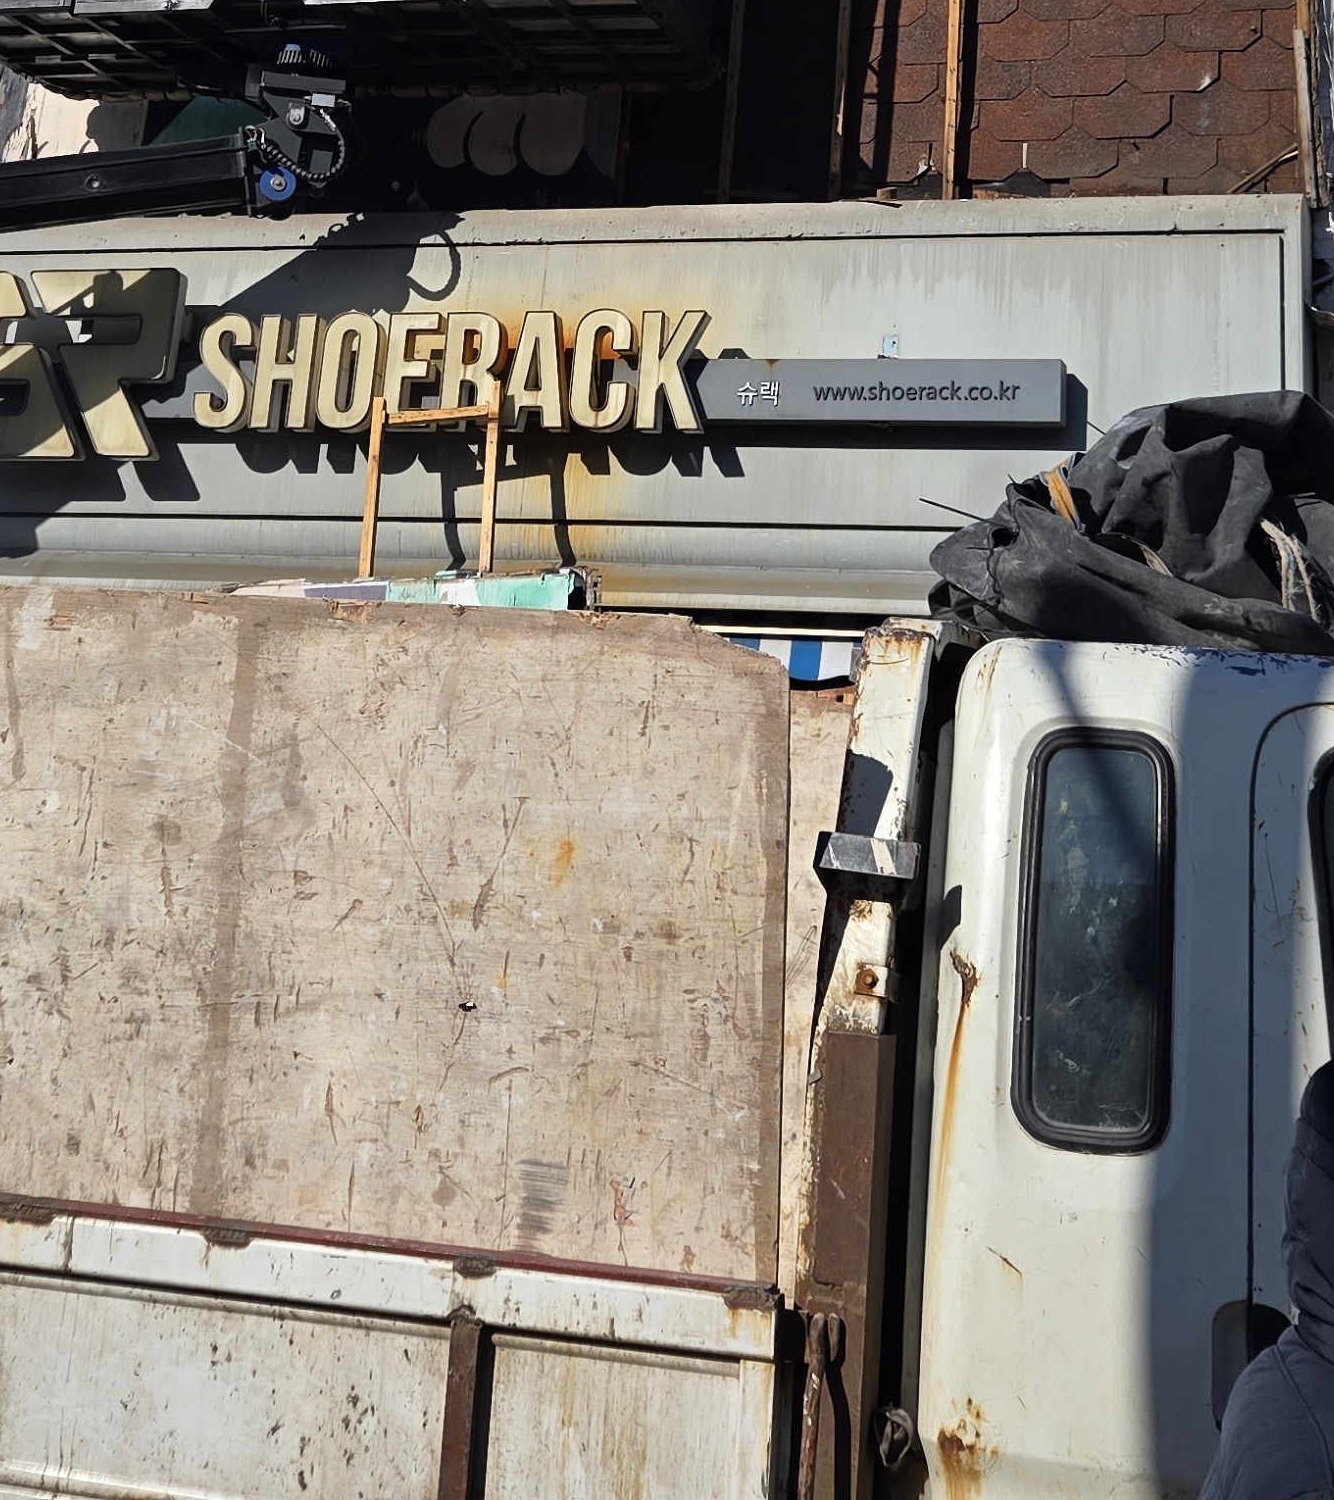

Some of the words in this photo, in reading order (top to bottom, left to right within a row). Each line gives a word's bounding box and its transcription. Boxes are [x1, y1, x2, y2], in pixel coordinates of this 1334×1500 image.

[192, 308, 710, 433] SHOERACK
[737, 381, 780, 406] 슈랙
[813, 380, 1020, 402] www.shoerack.co.kr
